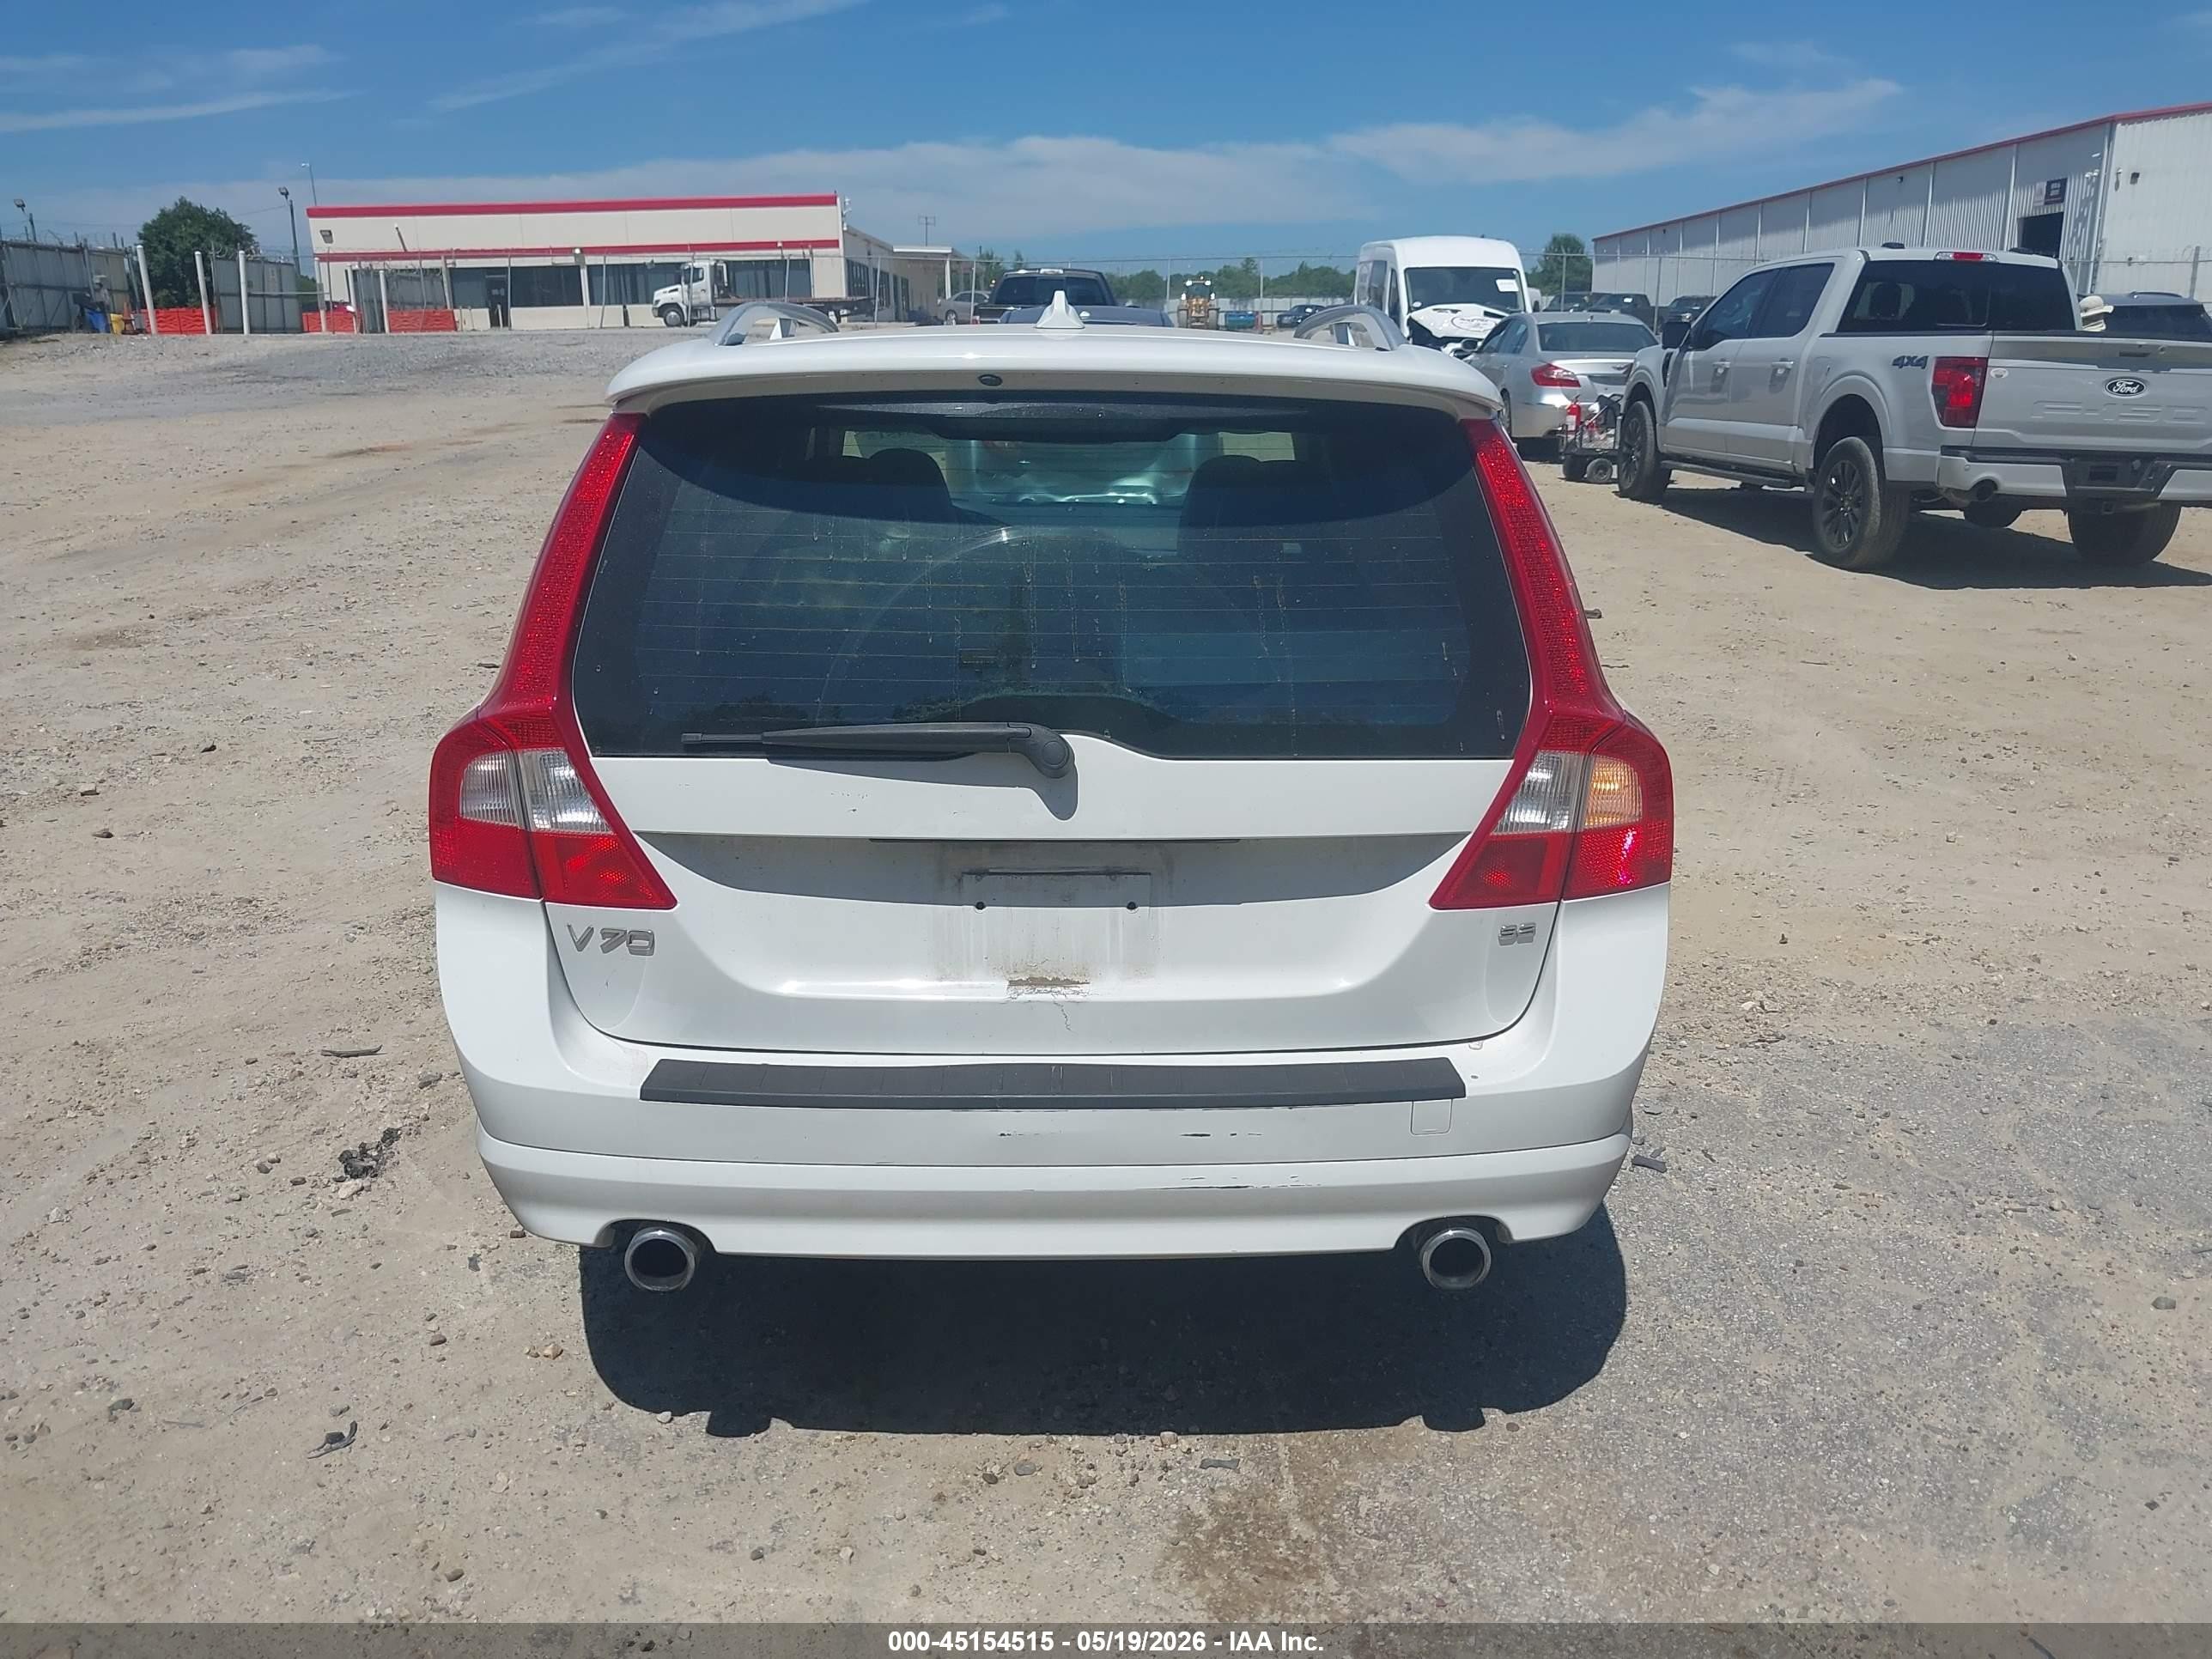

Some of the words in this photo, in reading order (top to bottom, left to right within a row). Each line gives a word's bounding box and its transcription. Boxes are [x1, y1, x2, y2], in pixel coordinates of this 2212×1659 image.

[2112, 380, 2140, 395] Ford
[2031, 400, 2209, 424] F-150
[567, 924, 655, 956] V70
